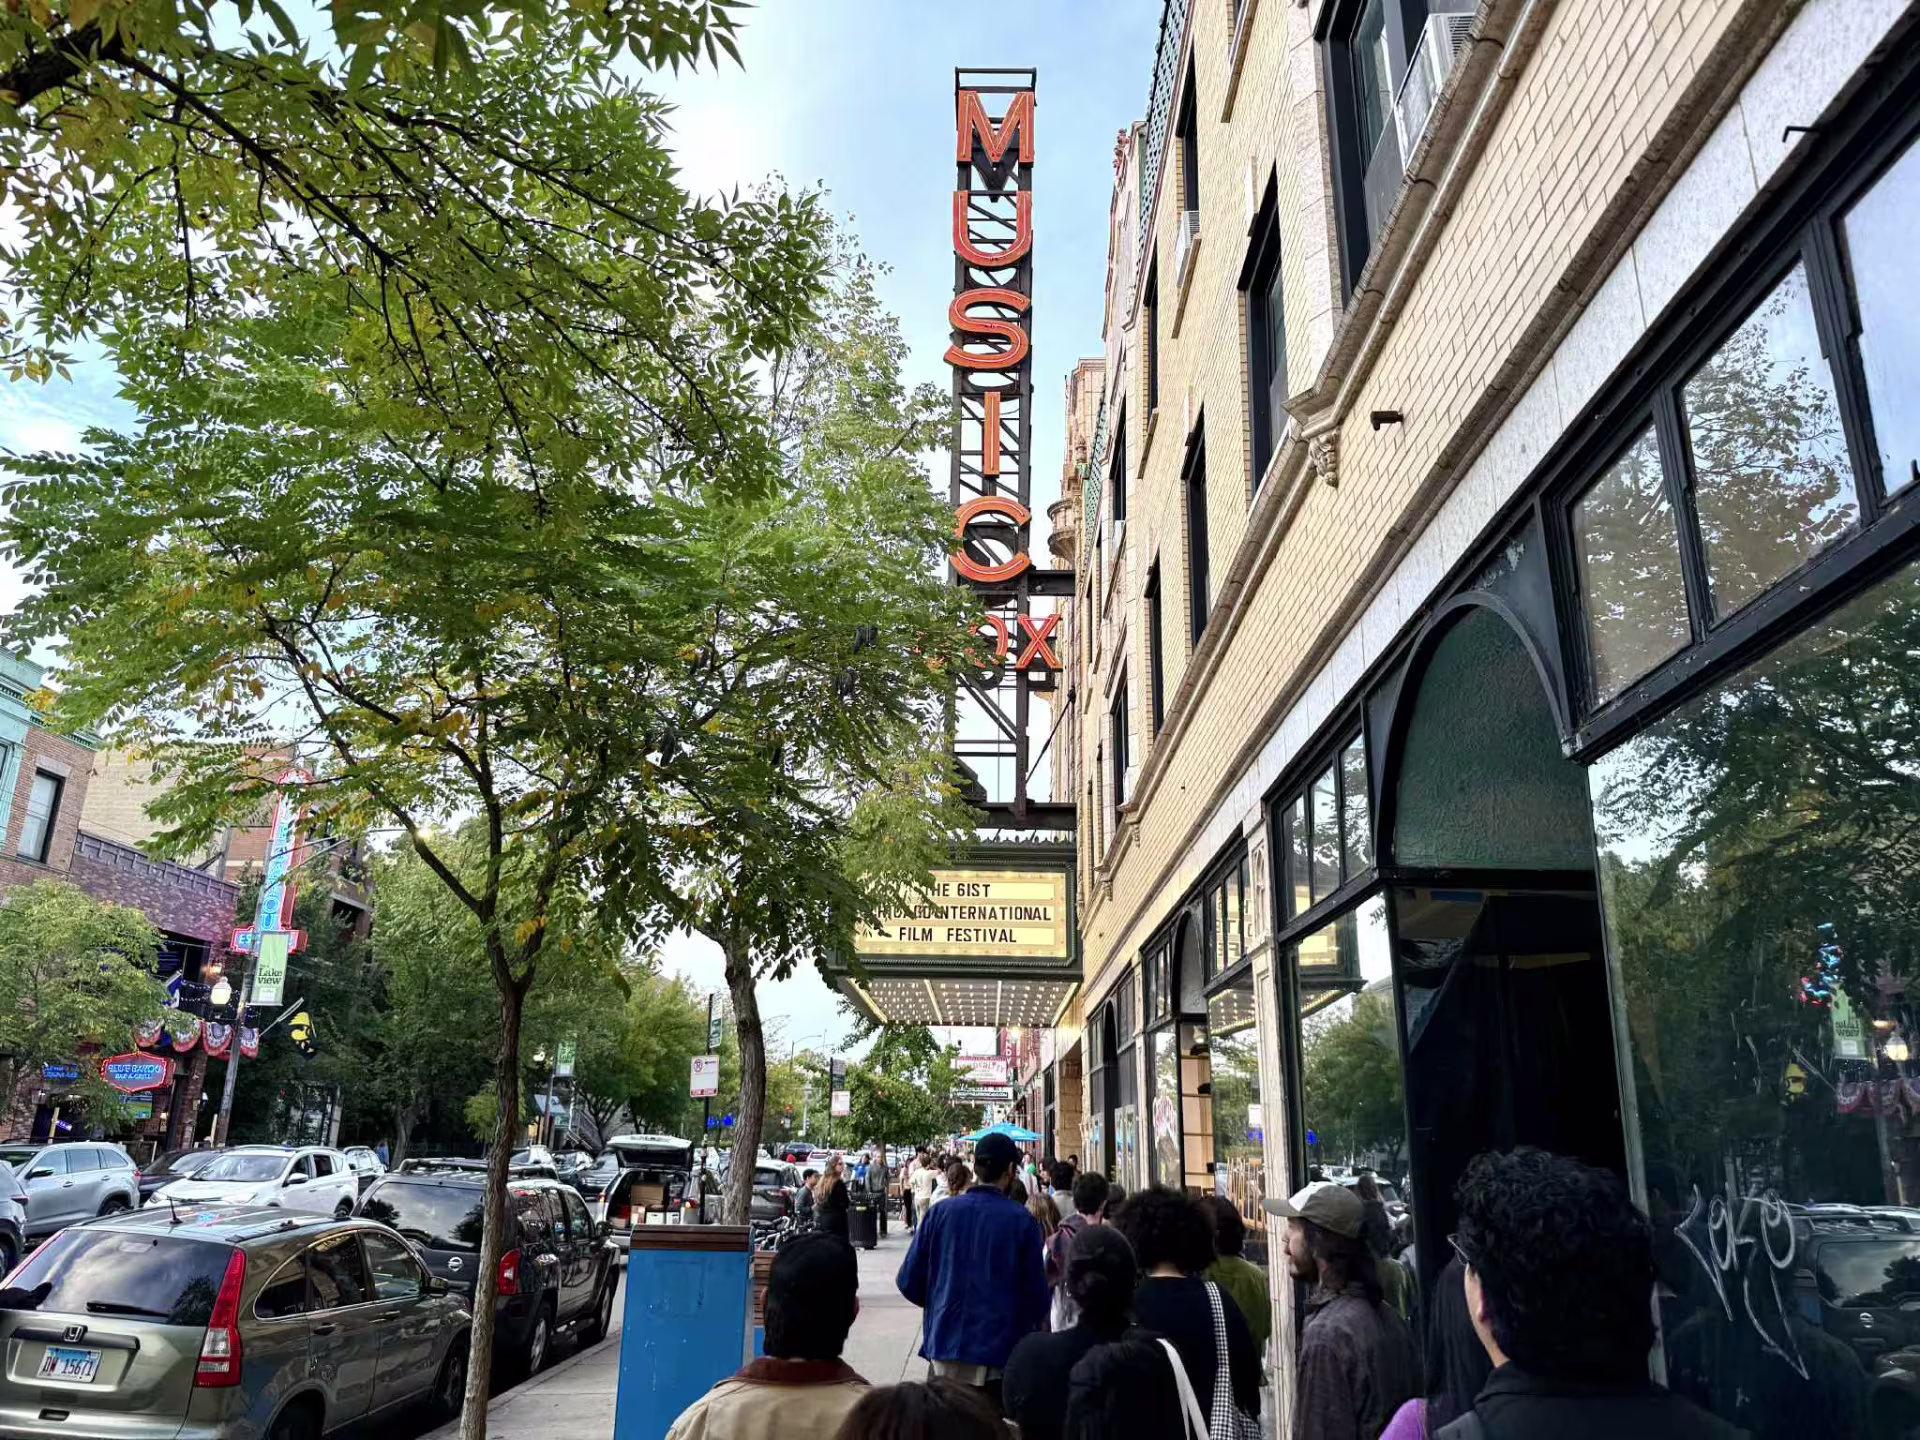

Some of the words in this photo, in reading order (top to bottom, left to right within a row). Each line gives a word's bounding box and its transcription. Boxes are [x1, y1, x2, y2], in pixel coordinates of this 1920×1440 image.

[944, 90, 1034, 583] MUSIC
[935, 905, 1051, 921] NTERNATIONAL
[899, 926, 933, 942] FILM
[947, 928, 1017, 943] FESTIVAL
[61, 1358, 93, 1376] 15671
